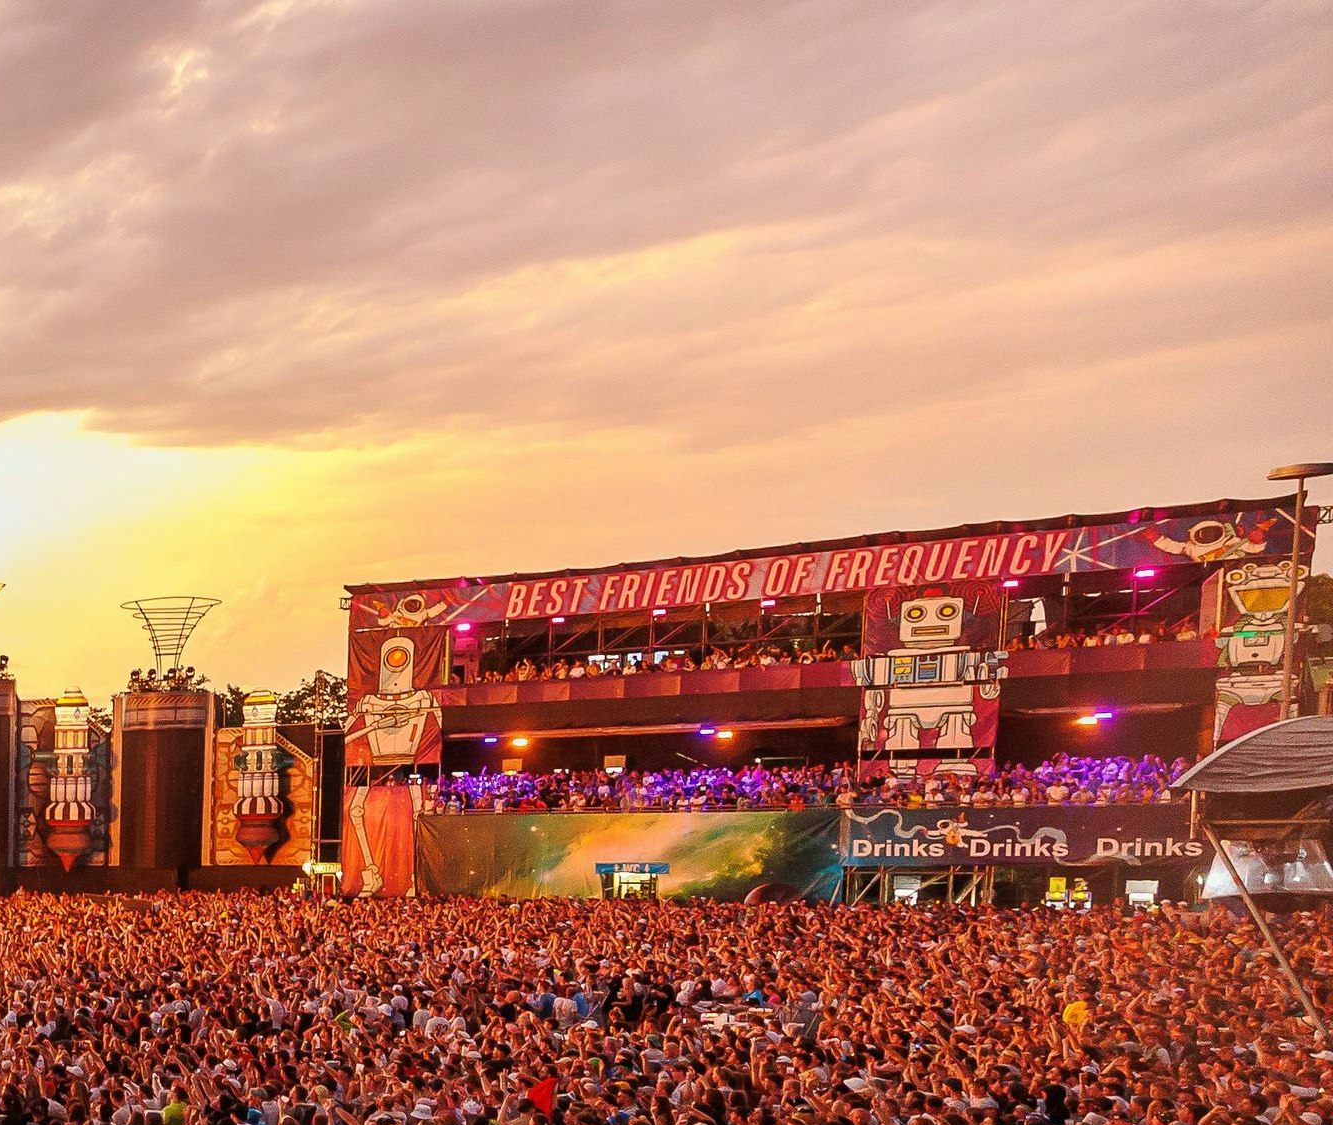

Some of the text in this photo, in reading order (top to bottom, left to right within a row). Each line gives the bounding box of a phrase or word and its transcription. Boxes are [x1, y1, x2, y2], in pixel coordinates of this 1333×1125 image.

[505, 533, 1068, 619] BEST FRIENDS OF FREQUENCY
[853, 838, 944, 857] Drinks
[970, 838, 1069, 858] Drinks
[1097, 837, 1203, 857] Drinks
